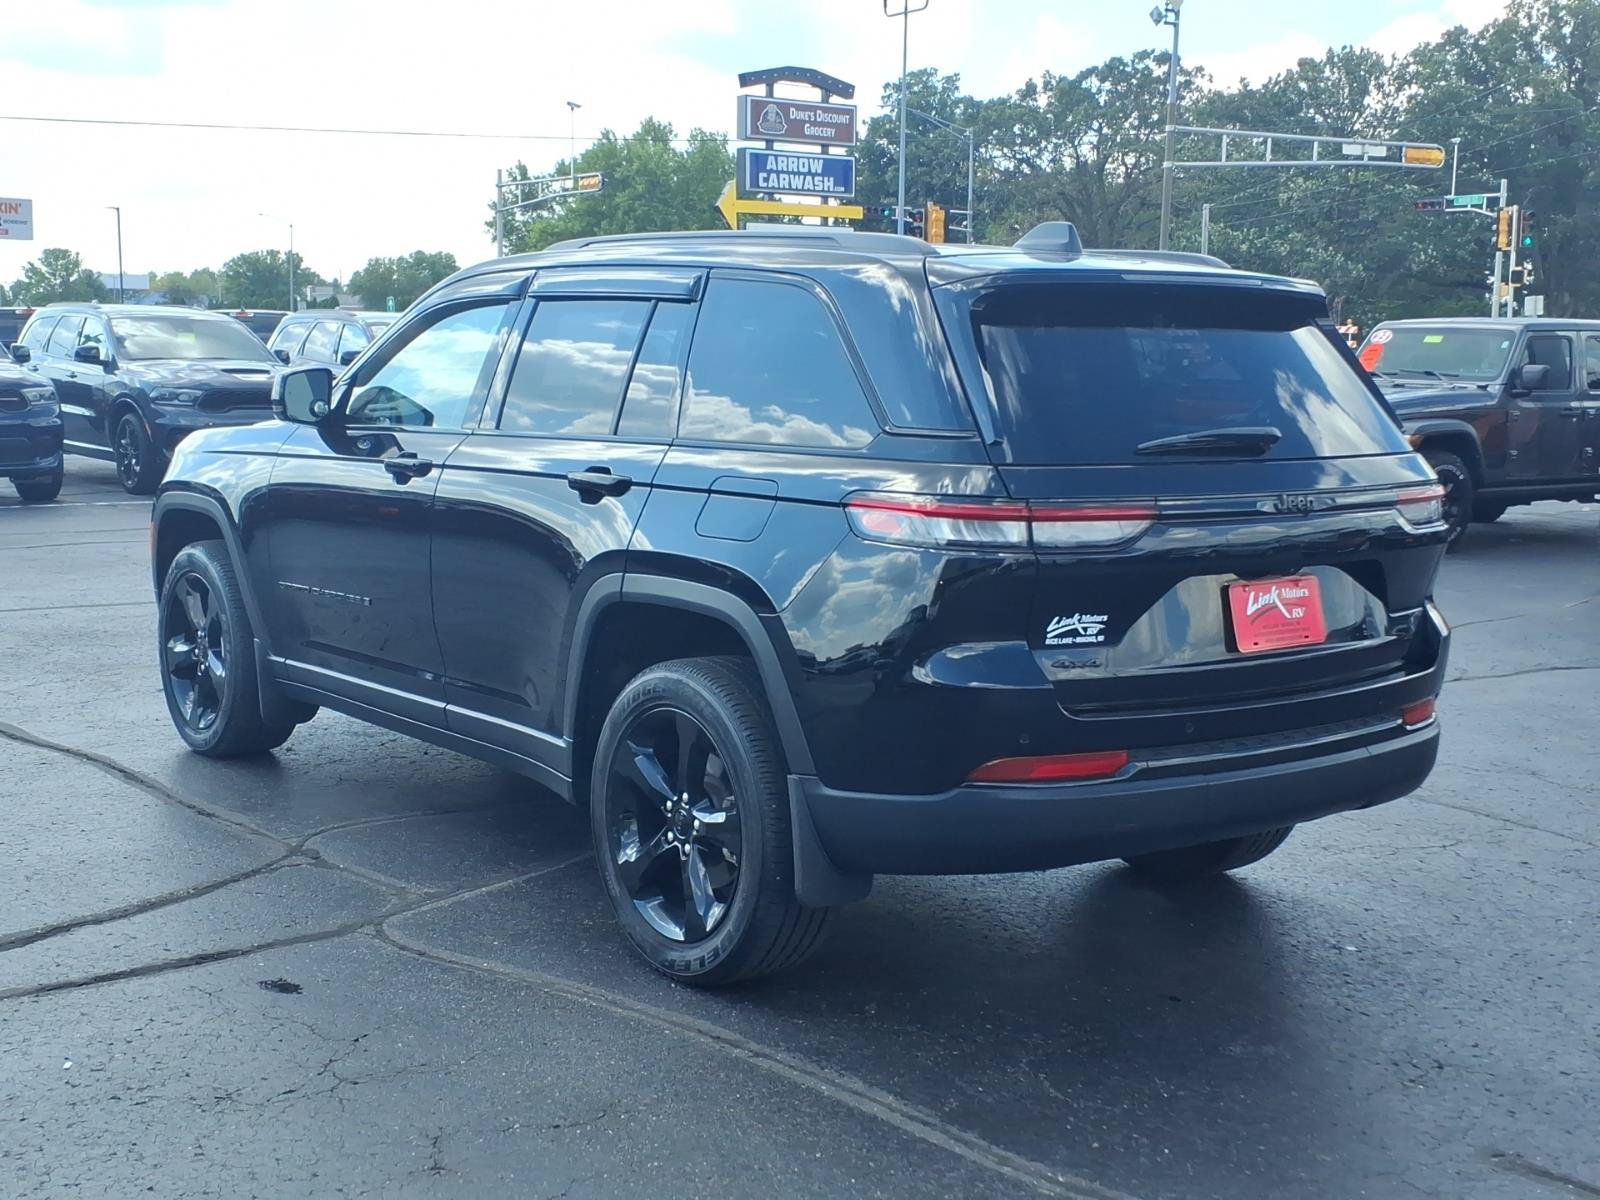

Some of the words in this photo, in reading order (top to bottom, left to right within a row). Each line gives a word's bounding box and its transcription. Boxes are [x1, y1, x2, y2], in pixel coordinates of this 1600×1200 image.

[790, 107, 815, 121] DUKE'S
[816, 109, 850, 124] DISCOUNT
[804, 123, 836, 137] GROCERY
[766, 155, 824, 174] ARROW
[1279, 494, 1319, 511] Jeep
[1246, 585, 1292, 619] Link
[1280, 587, 1309, 599] Motors
[1292, 607, 1306, 619] RV
[1046, 613, 1086, 635] Link
